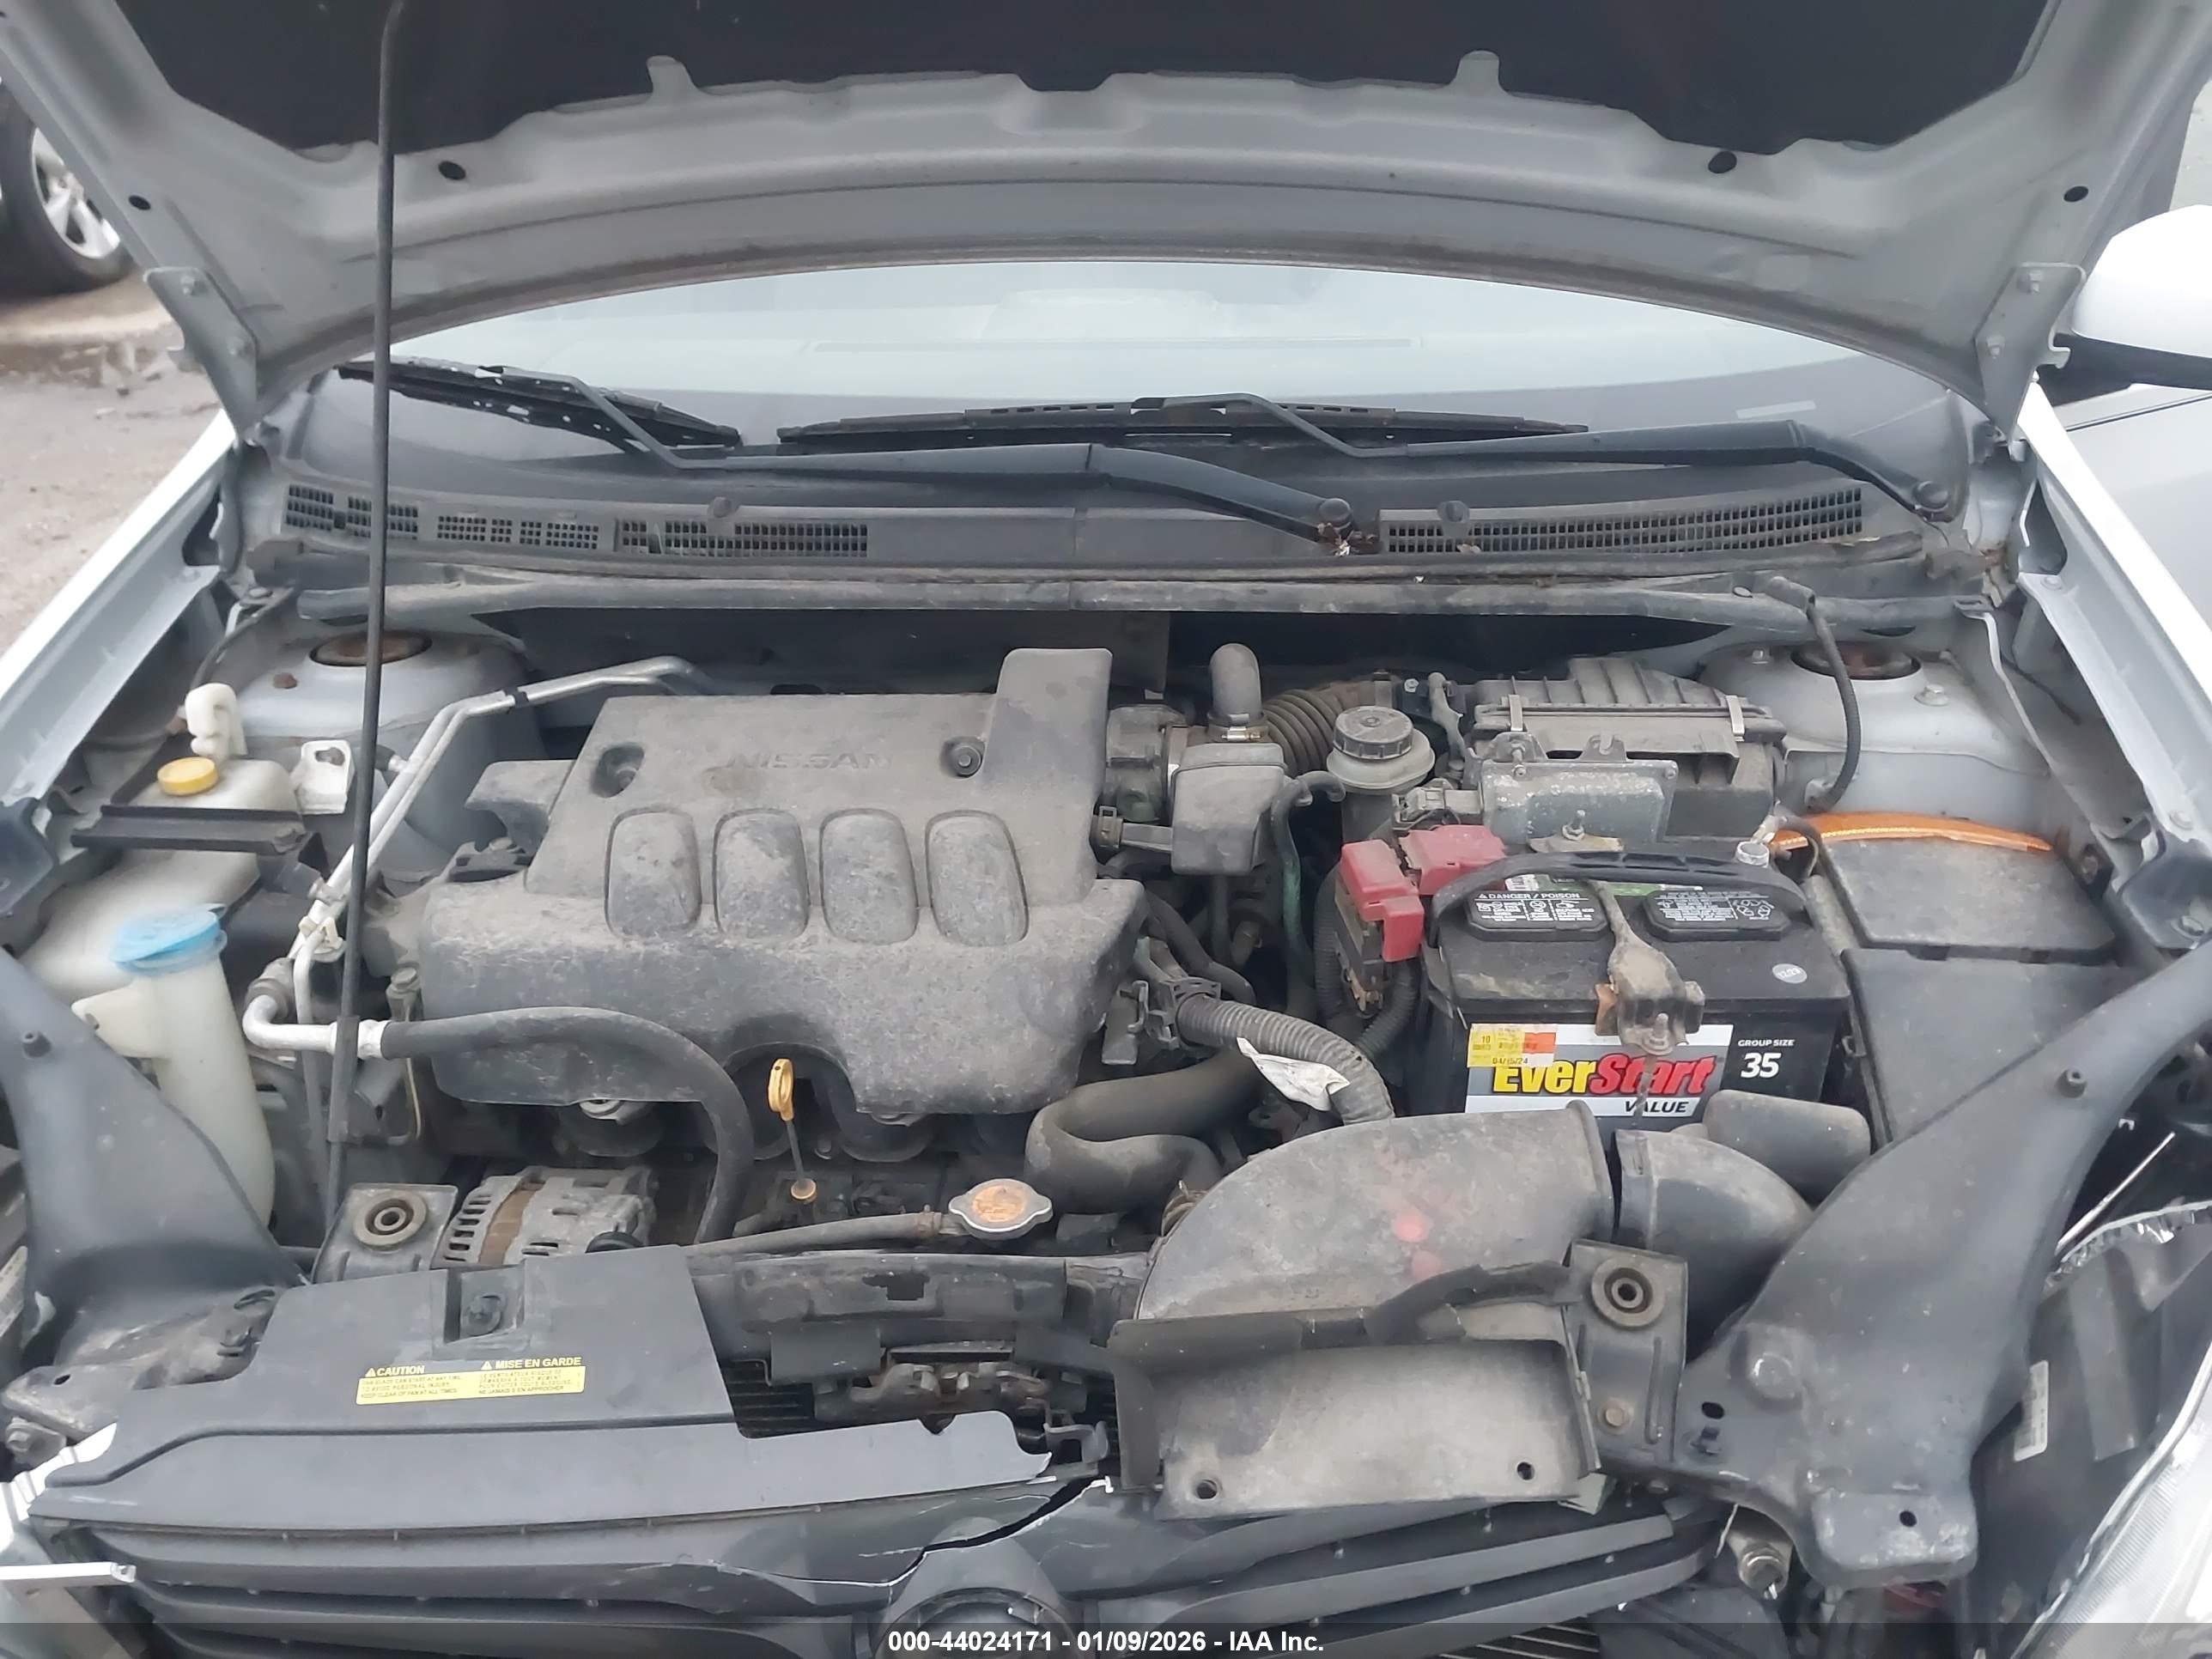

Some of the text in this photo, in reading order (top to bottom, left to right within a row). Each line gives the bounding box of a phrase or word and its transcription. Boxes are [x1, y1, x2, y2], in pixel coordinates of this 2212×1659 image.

[1741, 1052, 1782, 1079] 35
[495, 1357, 582, 1369] MISE EN GARDE
[377, 1364, 426, 1376] CAUTION
